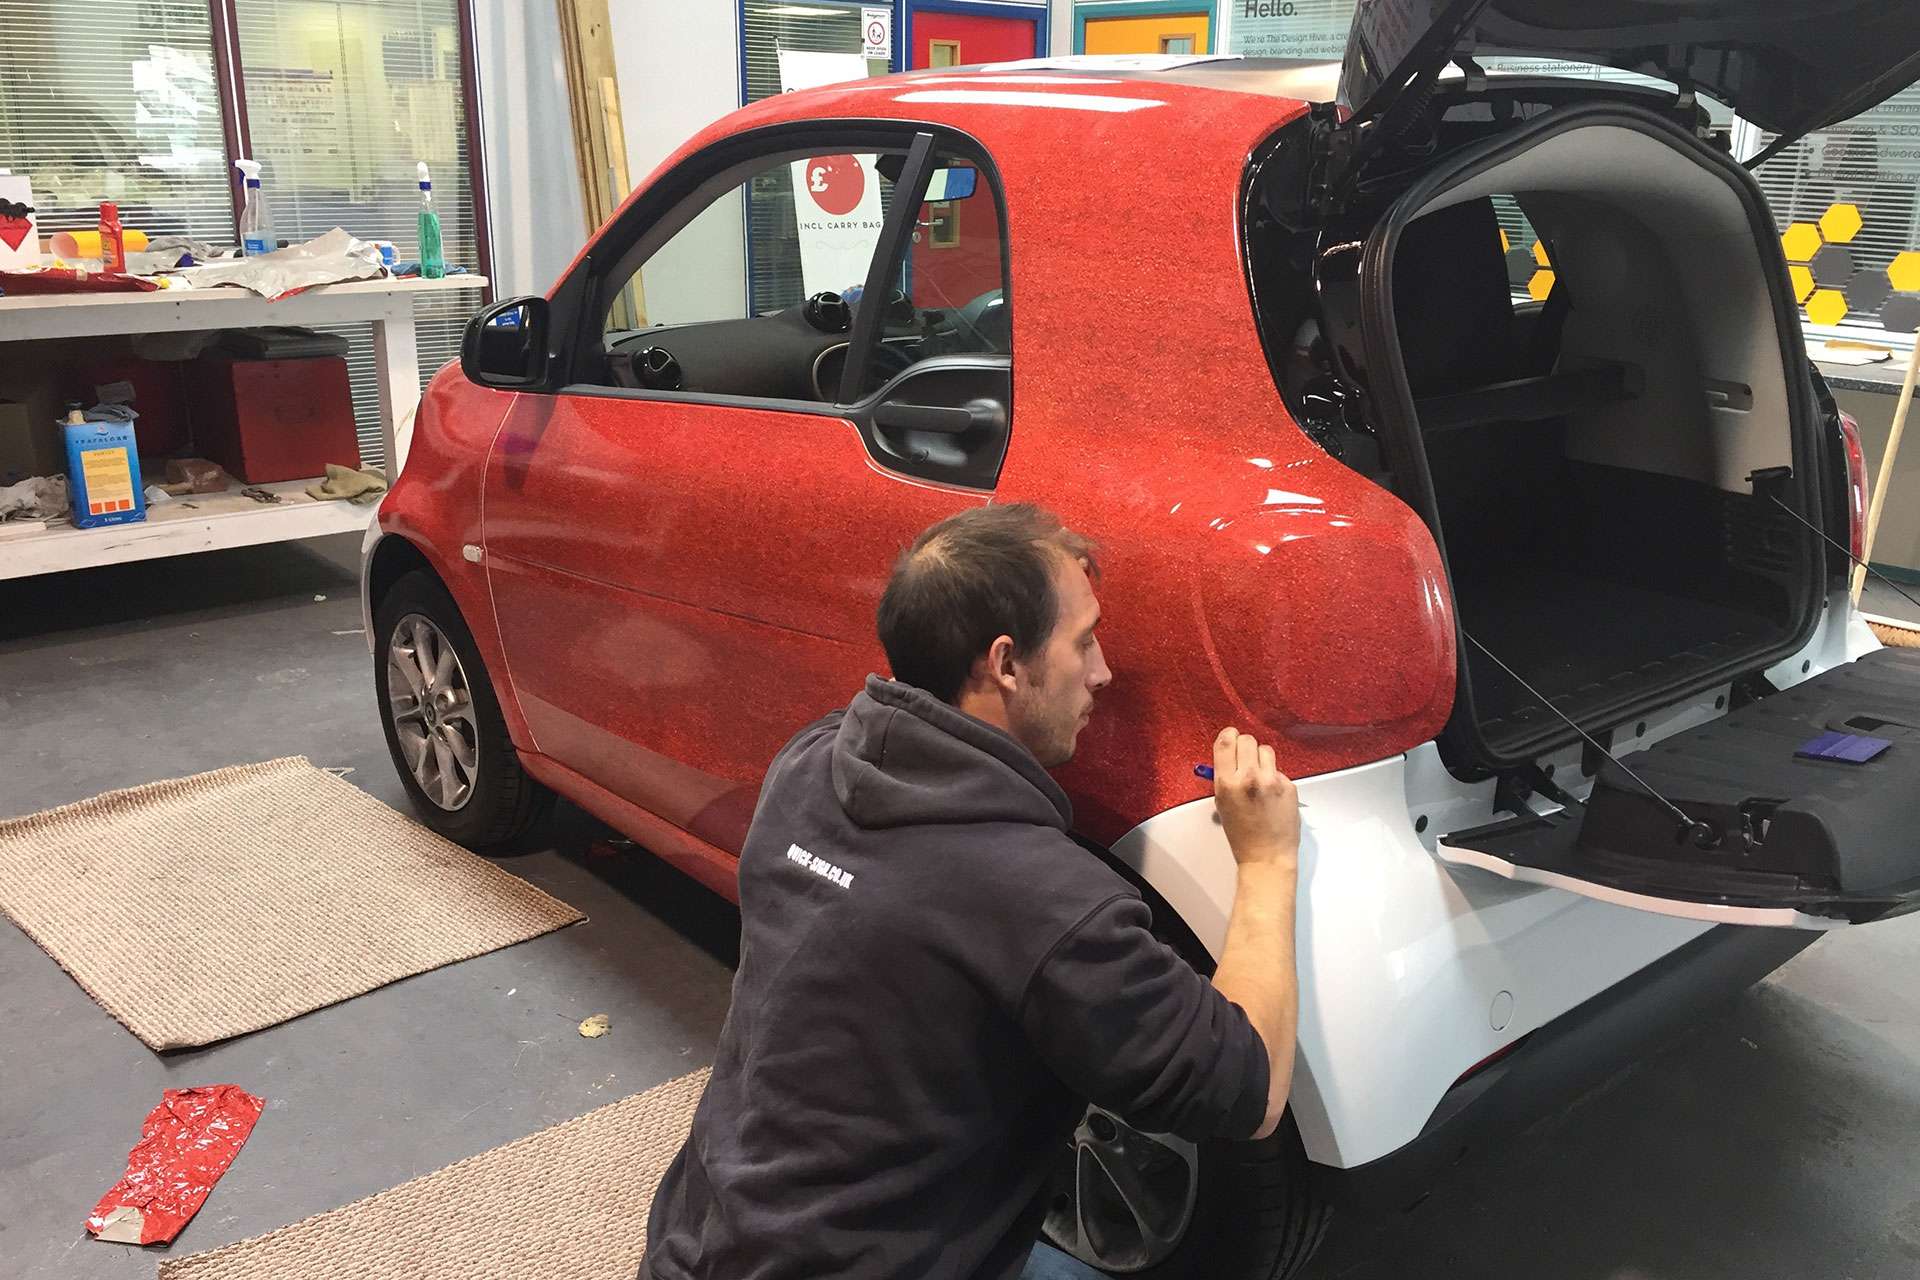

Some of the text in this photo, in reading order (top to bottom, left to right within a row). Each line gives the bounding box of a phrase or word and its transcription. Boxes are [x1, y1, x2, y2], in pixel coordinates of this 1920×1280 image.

[1244, 0, 1298, 18] Hello.
[1266, 34, 1280, 43] The
[1269, 46, 1303, 56] branding
[1304, 46, 1319, 54] and
[1497, 62, 1593, 74] Business stationery
[800, 222, 823, 230] INCL
[862, 221, 881, 229] BAG
